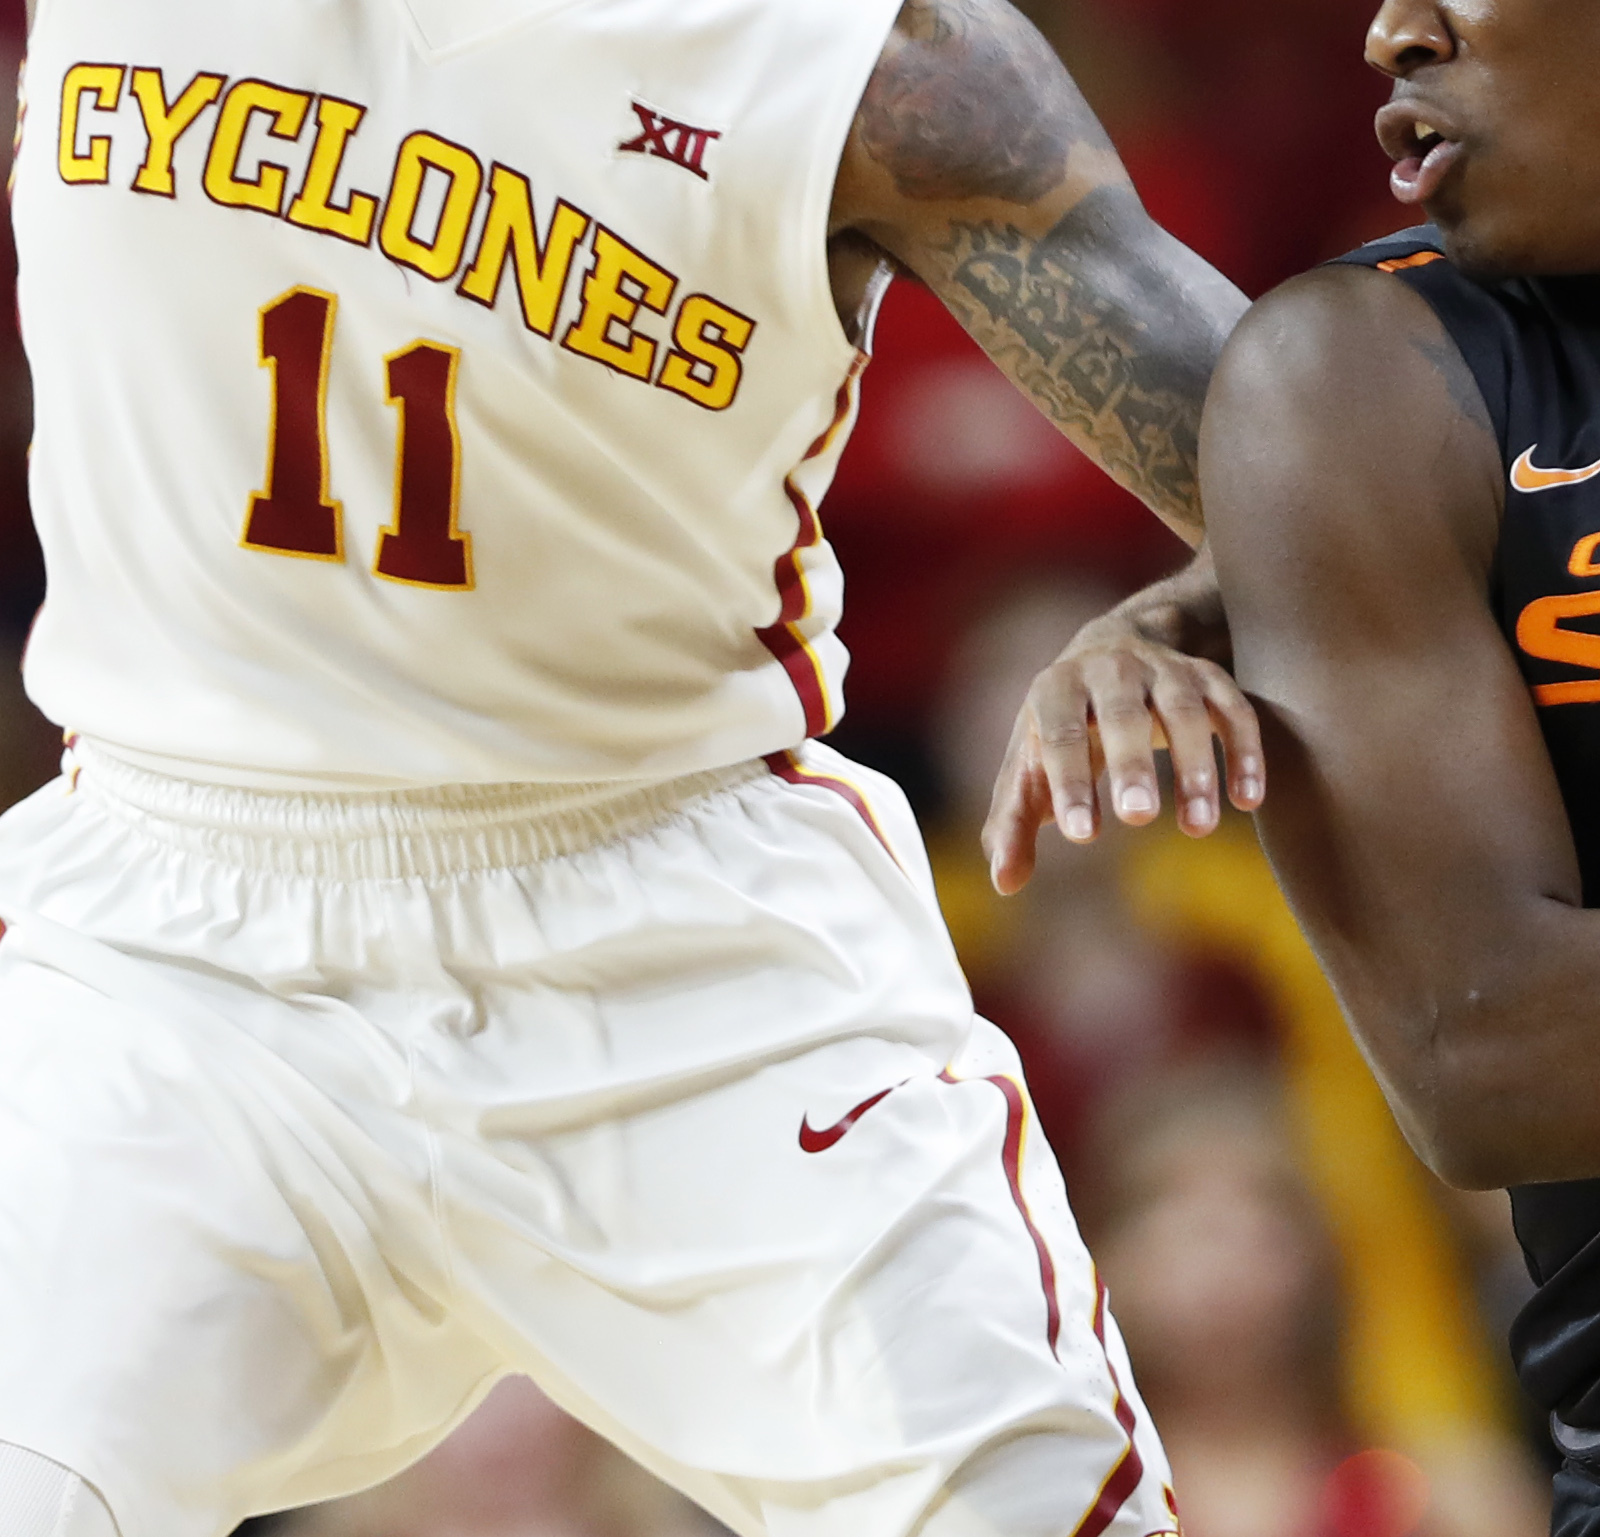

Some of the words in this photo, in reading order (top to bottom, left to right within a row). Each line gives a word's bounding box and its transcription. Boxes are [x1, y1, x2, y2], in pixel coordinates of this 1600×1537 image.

[56, 60, 756, 412] CYCLONES
[617, 100, 723, 182] XII
[239, 284, 476, 592] 11
